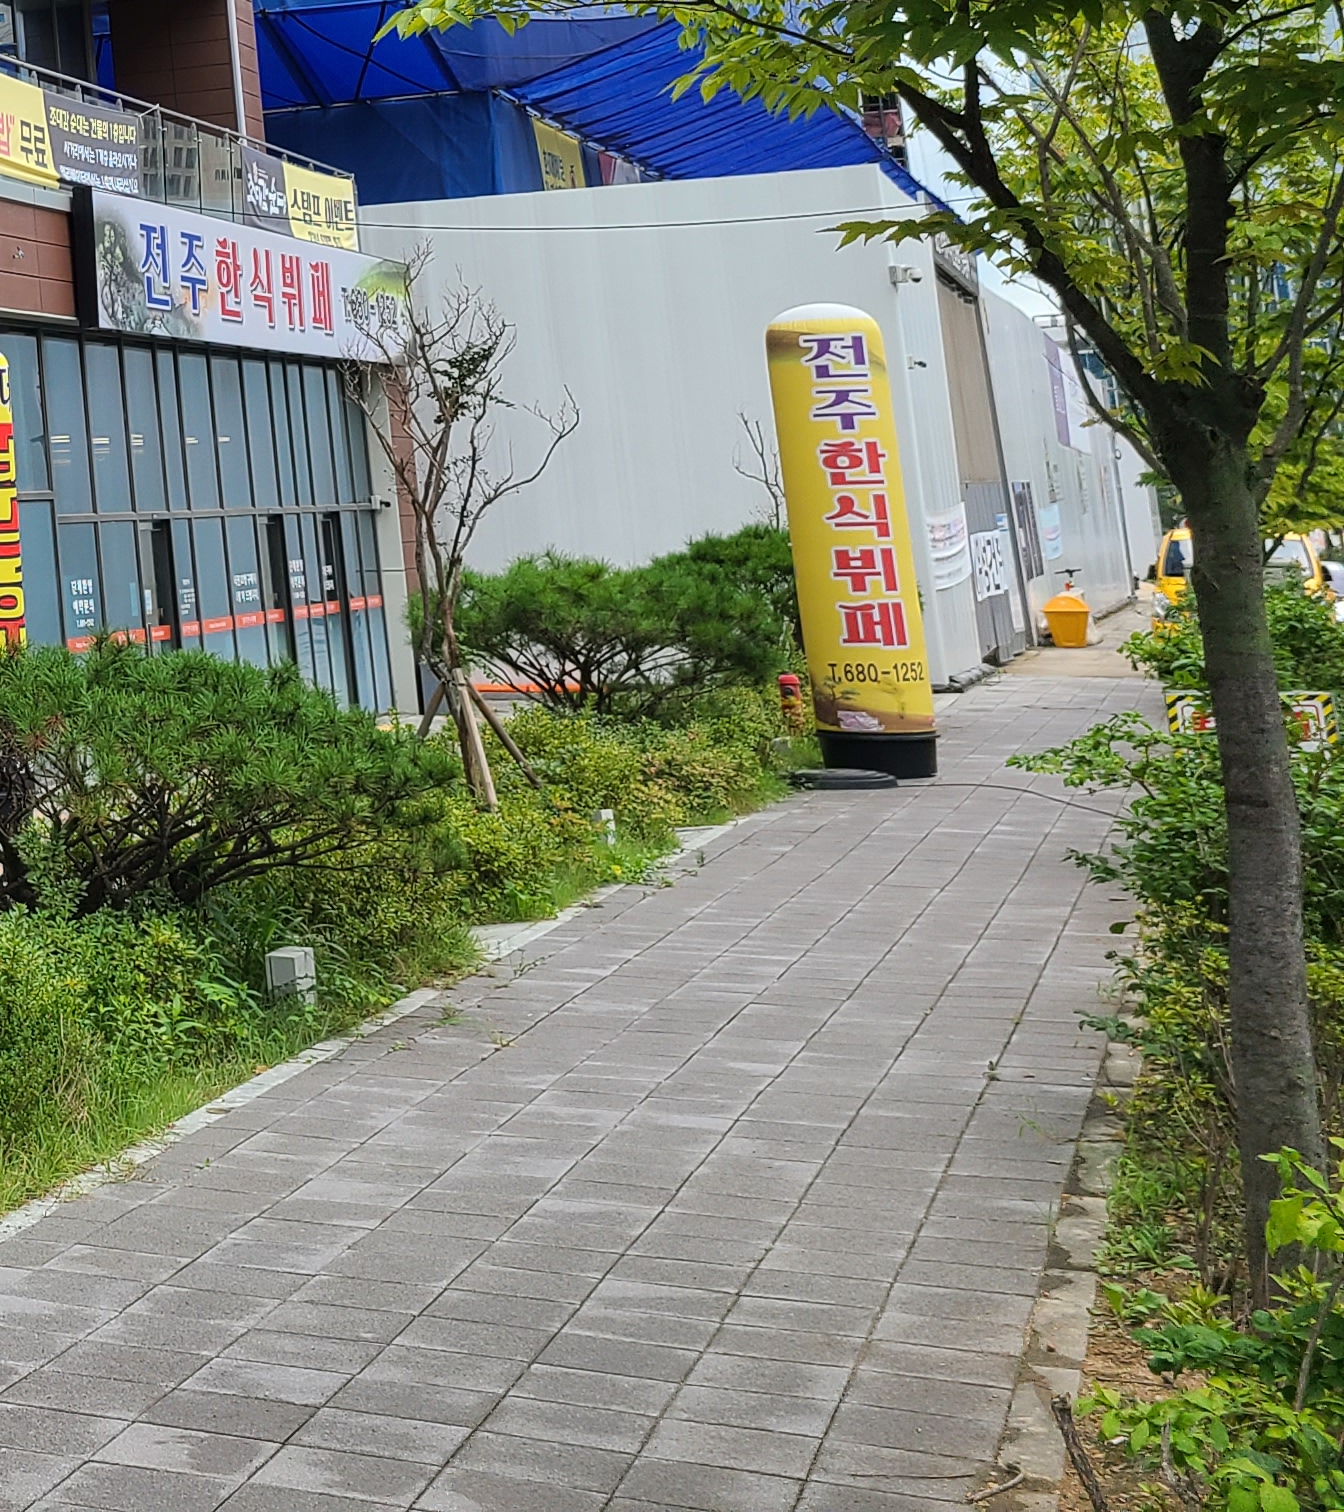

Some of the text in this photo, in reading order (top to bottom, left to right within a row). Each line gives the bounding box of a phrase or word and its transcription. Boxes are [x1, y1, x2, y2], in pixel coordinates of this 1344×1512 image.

[49, 106, 69, 130] 조대감
[69, 113, 90, 137] 순대는
[89, 118, 109, 140] 건물의
[19, 119, 48, 169] 무료
[324, 197, 355, 232] 이벤트
[827, 660, 926, 684] T.680-1252
